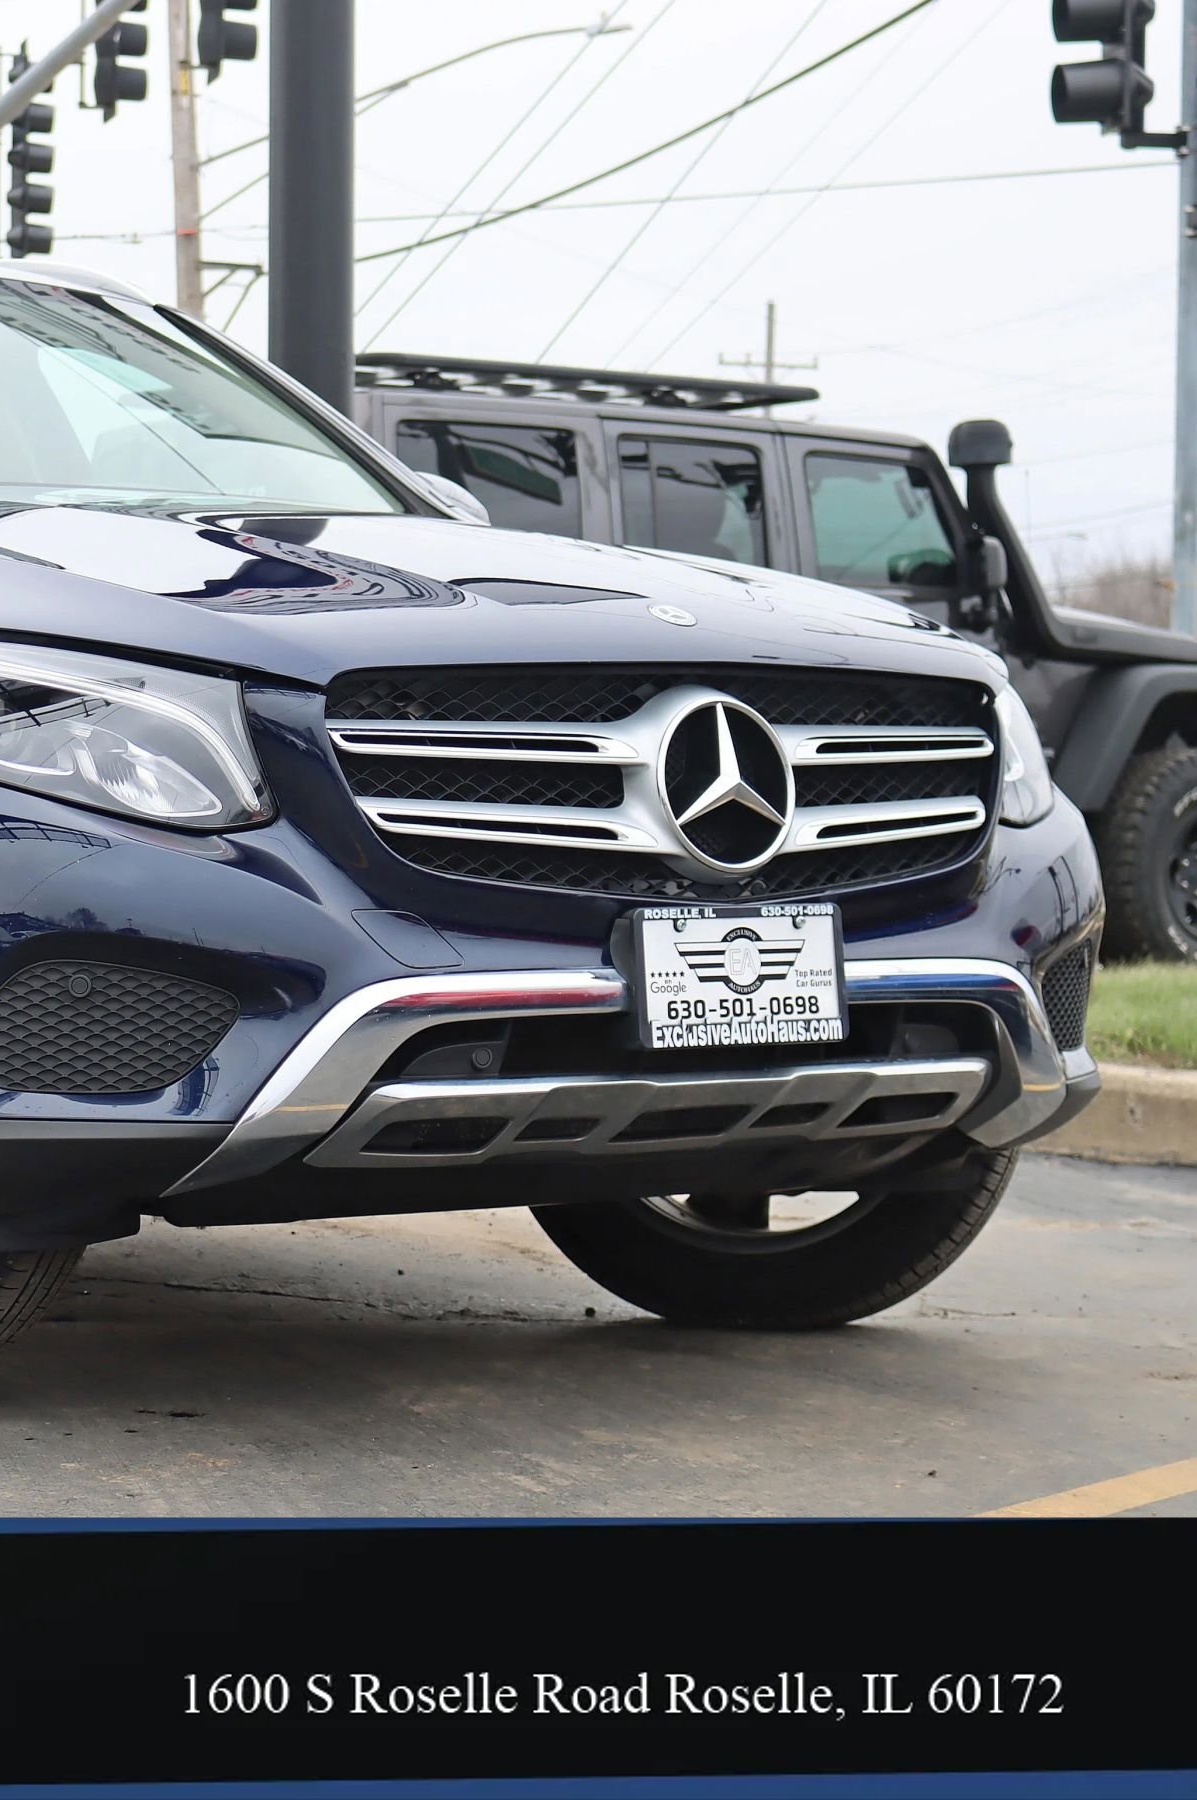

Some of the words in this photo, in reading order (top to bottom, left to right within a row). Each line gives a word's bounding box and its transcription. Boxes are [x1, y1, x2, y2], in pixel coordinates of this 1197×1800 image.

[644, 908, 701, 920] ROSELLE,
[704, 908, 716, 918] IL
[761, 905, 834, 917] 630-501-0698
[795, 970, 808, 978] Top
[810, 969, 832, 977] Rated
[650, 982, 687, 996] Google
[667, 996, 820, 1020] 630-501-0698
[653, 1016, 843, 1049] ExclusiveAutoHaus.com
